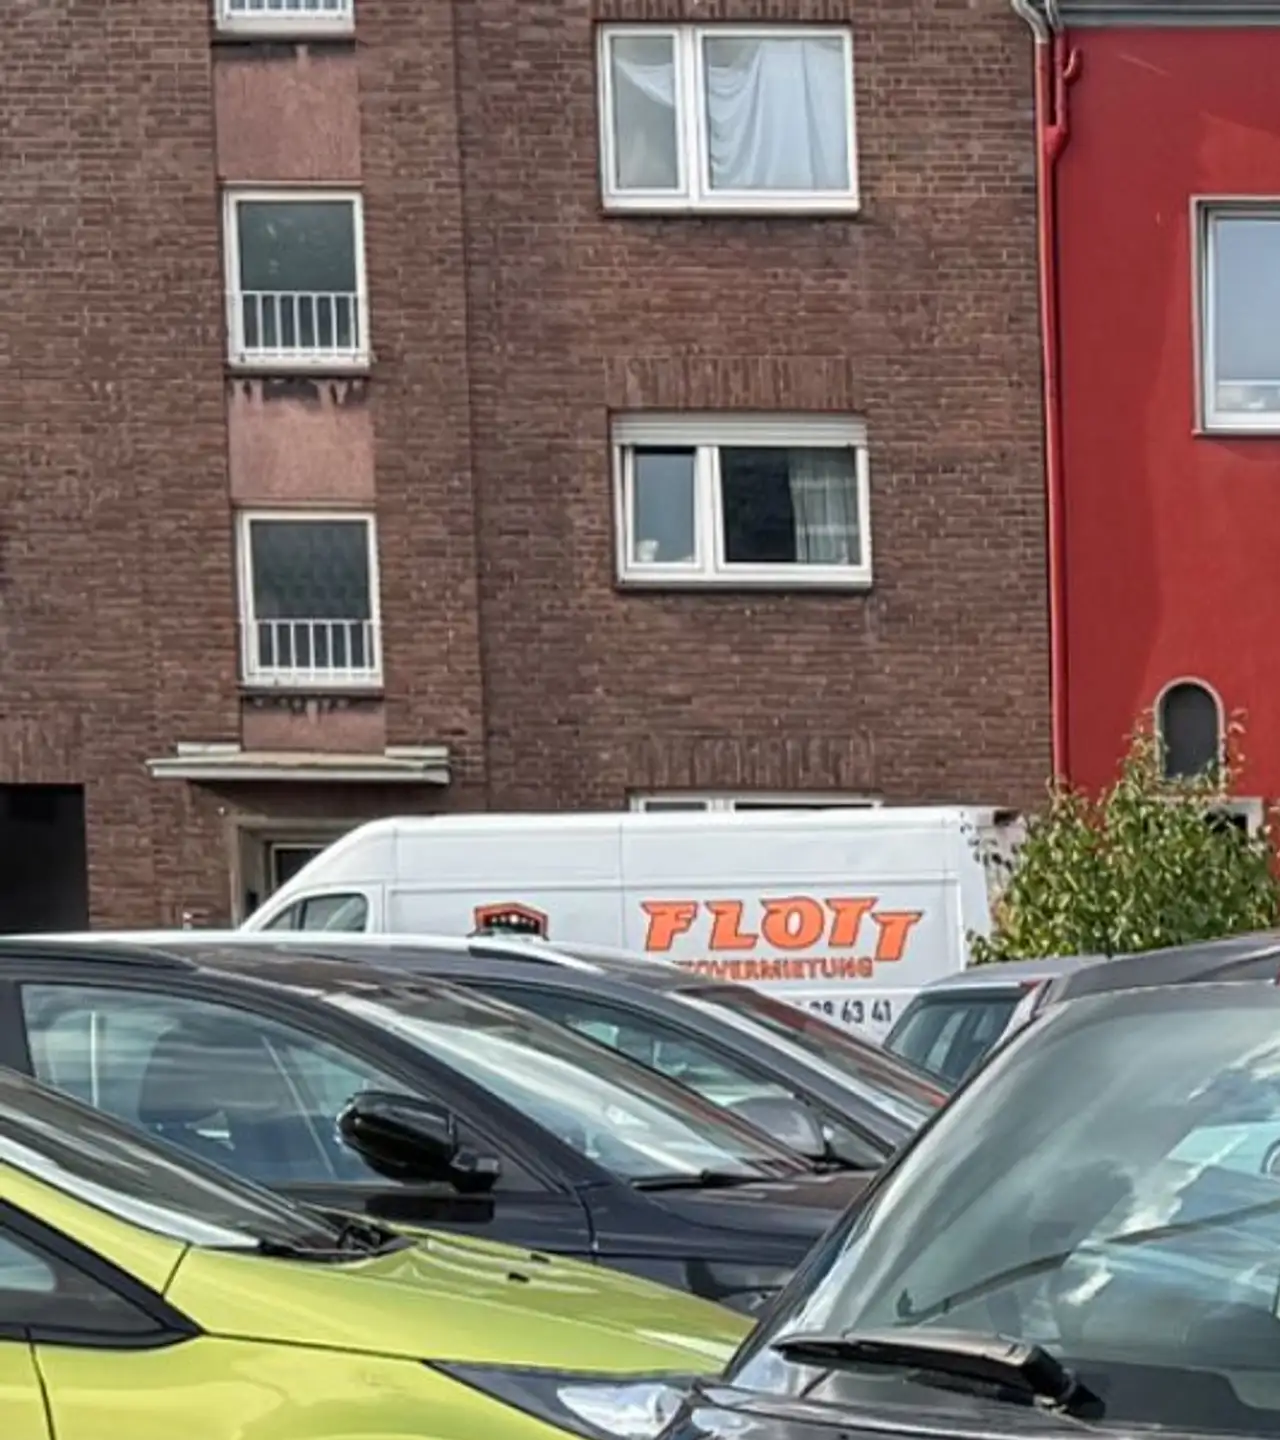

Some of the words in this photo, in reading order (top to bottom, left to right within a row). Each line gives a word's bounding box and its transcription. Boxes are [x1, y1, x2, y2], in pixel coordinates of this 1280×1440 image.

[641, 896, 924, 962] FLOTT
[841, 999, 864, 1023] 63
[870, 1000, 892, 1021] 41
